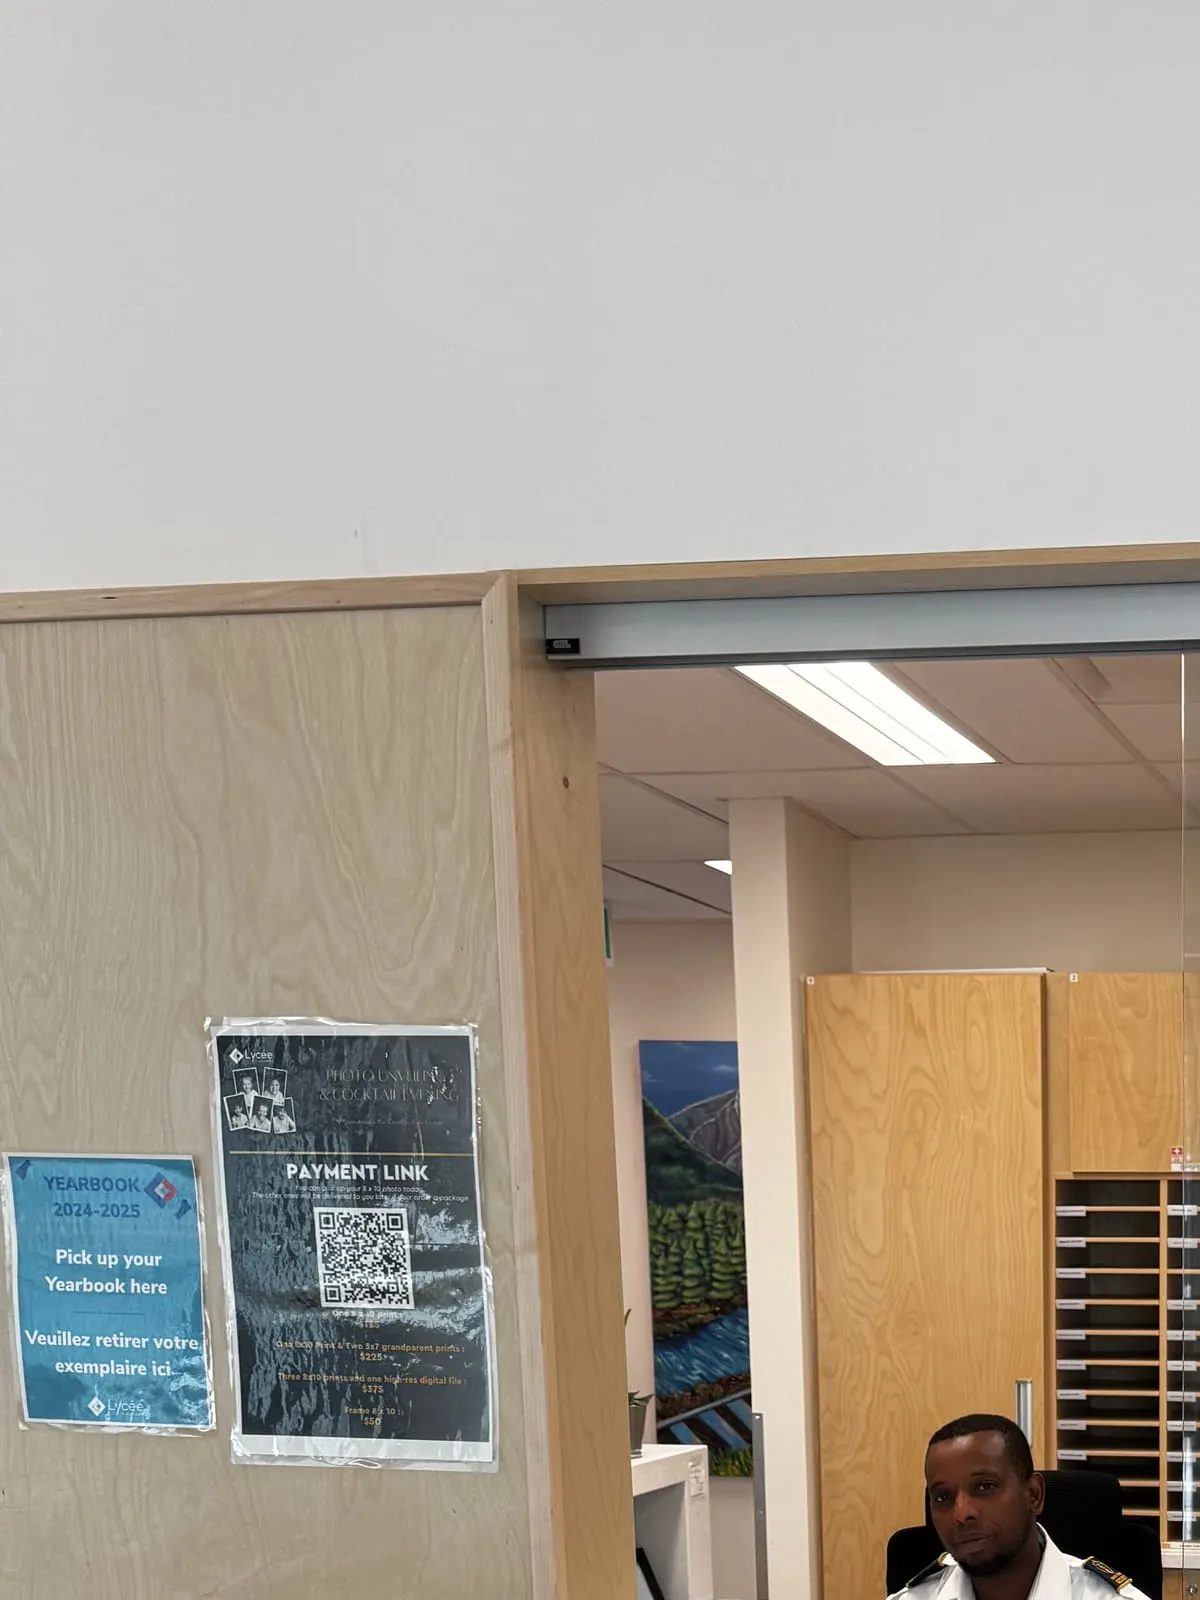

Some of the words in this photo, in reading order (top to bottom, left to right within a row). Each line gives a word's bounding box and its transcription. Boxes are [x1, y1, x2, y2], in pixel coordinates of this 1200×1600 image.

[244, 1049, 273, 1063] Lycée
[286, 1163, 378, 1180] PAYMENT
[383, 1164, 430, 1181] LINK
[43, 1175, 140, 1193] YEARBOOK
[53, 1202, 140, 1219] 2024-2025
[56, 1249, 92, 1265] Pick
[97, 1255, 119, 1269] up
[123, 1254, 163, 1270] your
[45, 1276, 126, 1294] Yearbook
[131, 1278, 168, 1294] here
[25, 1329, 91, 1347] Veuillez
[96, 1332, 149, 1348] retirer
[152, 1335, 199, 1350] votre
[381, 1343, 434, 1354] grandparent
[55, 1359, 147, 1377] exemplaire
[278, 1372, 301, 1381] Three
[419, 1375, 447, 1386] digital
[362, 1384, 384, 1394] $375
[107, 1399, 145, 1416] Lycée
